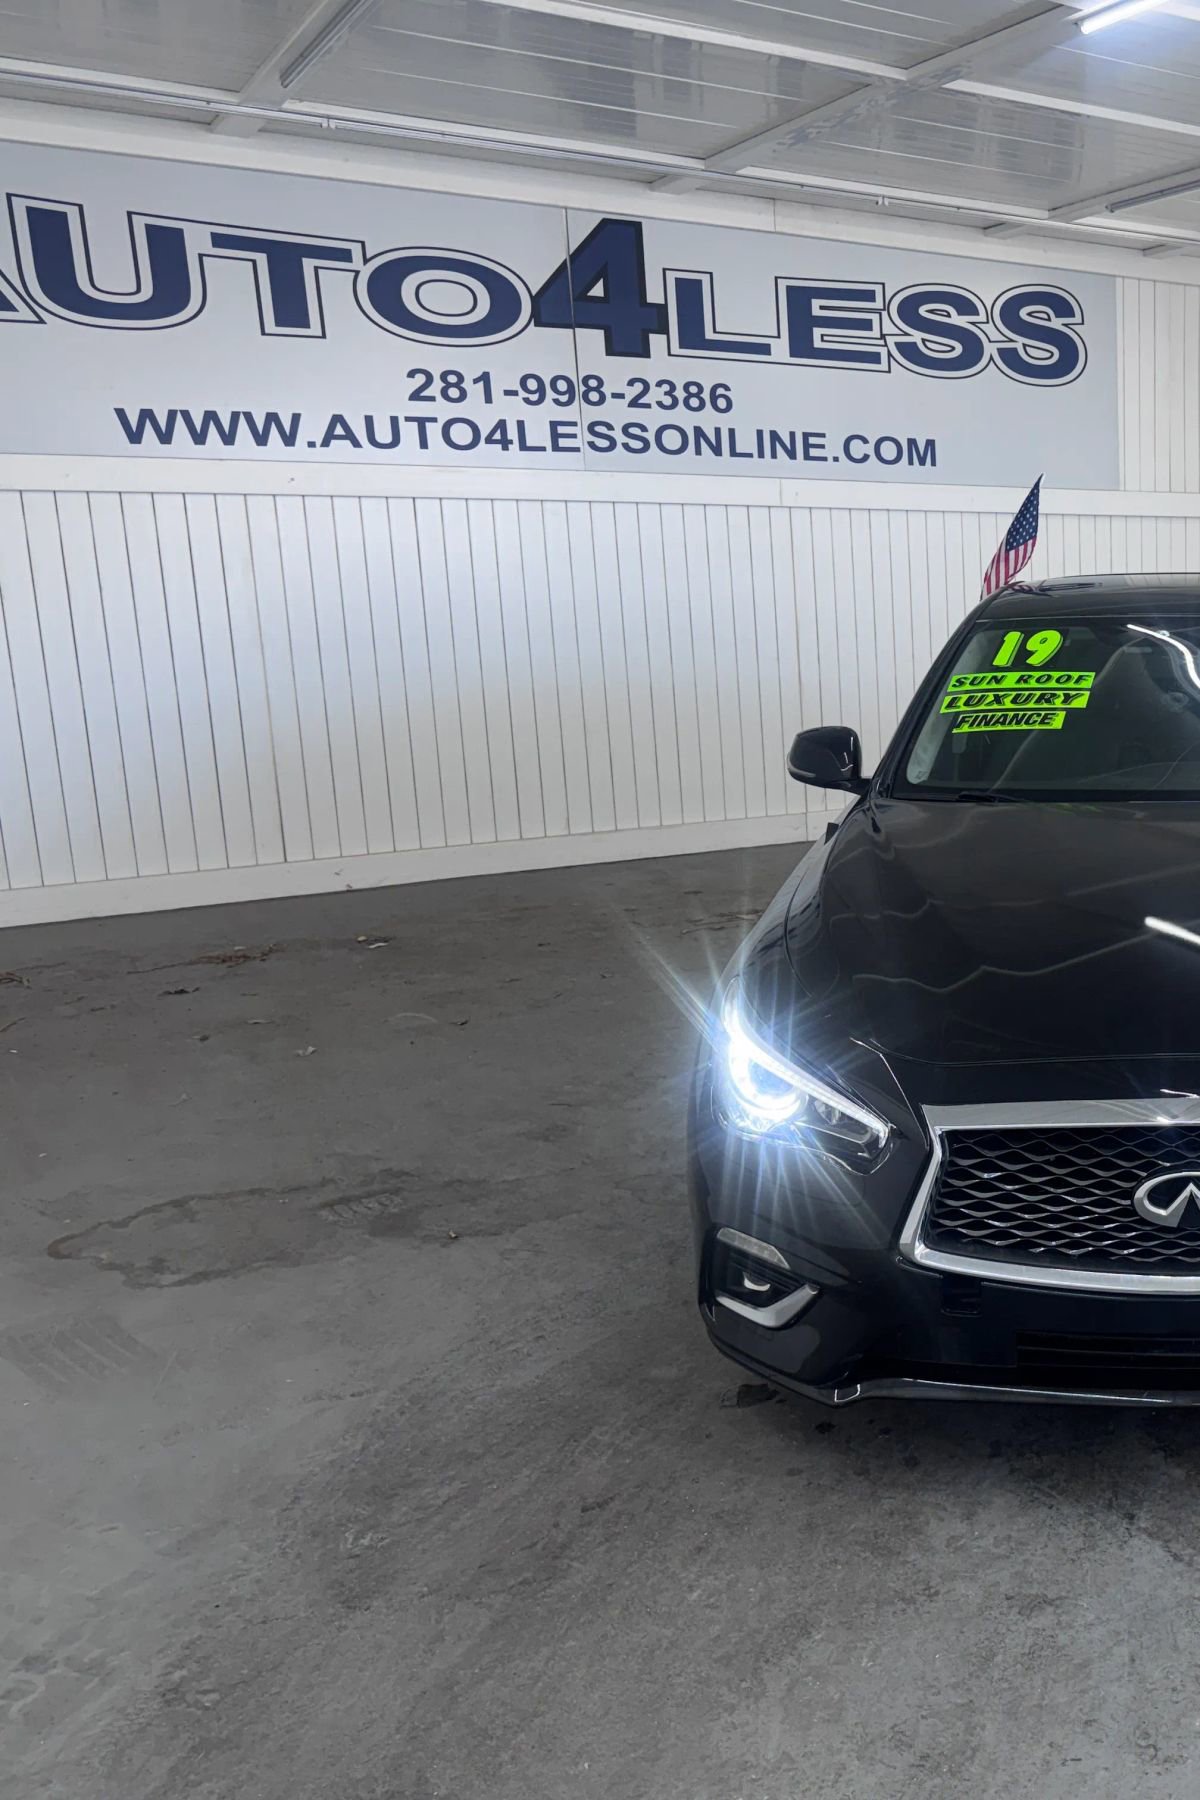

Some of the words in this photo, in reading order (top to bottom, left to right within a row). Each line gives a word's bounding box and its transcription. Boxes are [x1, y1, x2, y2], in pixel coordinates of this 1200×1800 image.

[0, 193, 1088, 387] UTO4LESS
[406, 368, 734, 414] 281-998-2386
[114, 407, 937, 467] WWW.AUTO4LESSONLINE.COM
[992, 629, 1064, 667] 19
[951, 674, 1008, 688] SUN
[1014, 673, 1092, 686] ROOF
[944, 691, 1083, 710] LUXURY
[955, 711, 1057, 730] FINANCE
